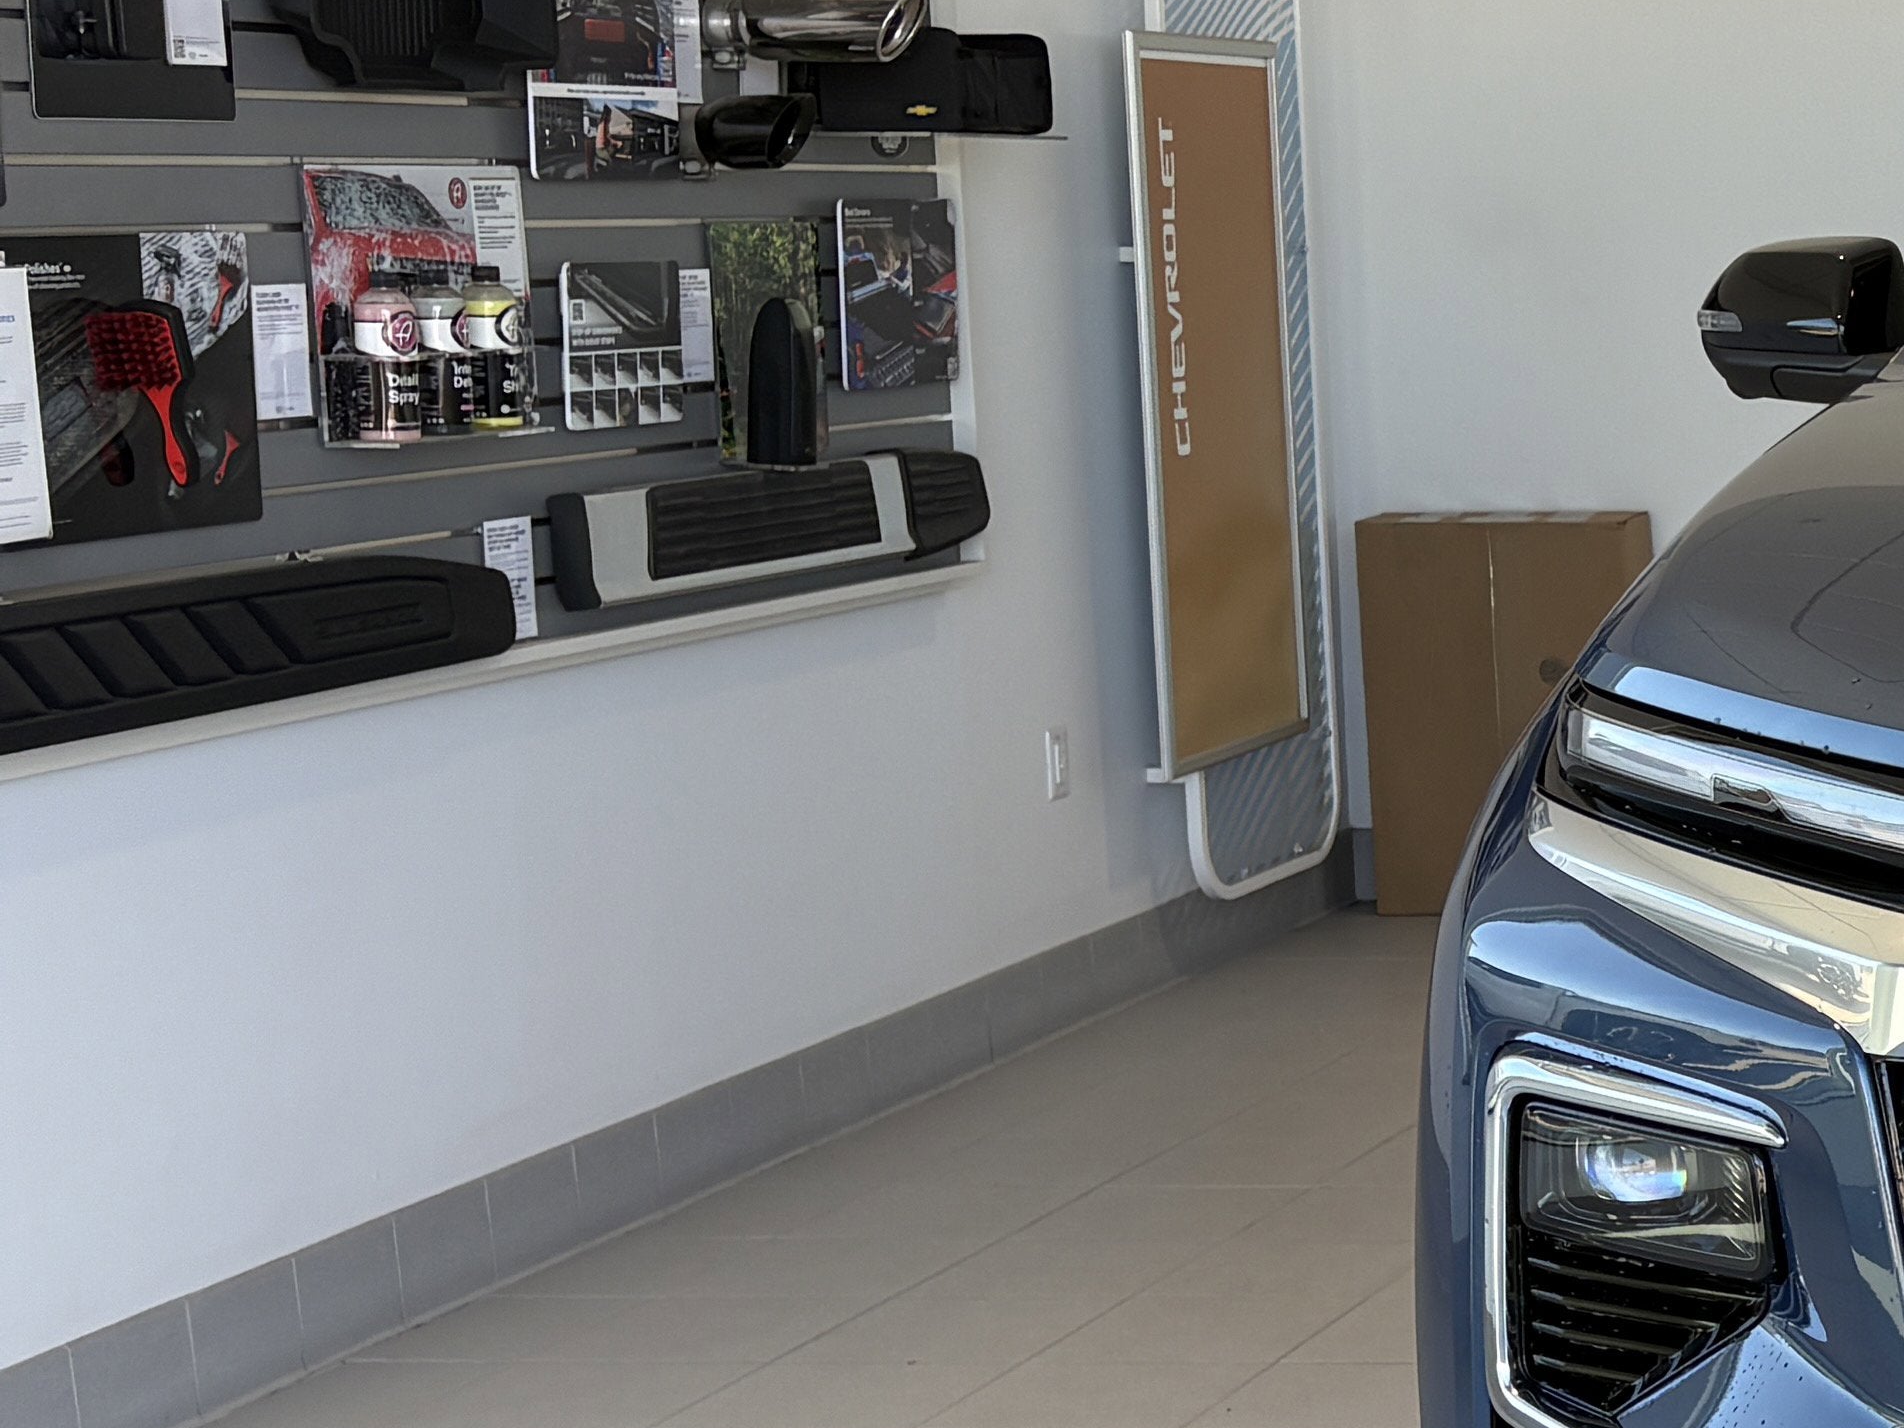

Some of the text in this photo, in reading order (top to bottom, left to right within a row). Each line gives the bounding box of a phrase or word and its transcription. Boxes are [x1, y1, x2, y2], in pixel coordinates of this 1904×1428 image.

[1158, 117, 1192, 457] CHEVROLET
[387, 372, 419, 388] Detail
[388, 389, 420, 407] Spray
